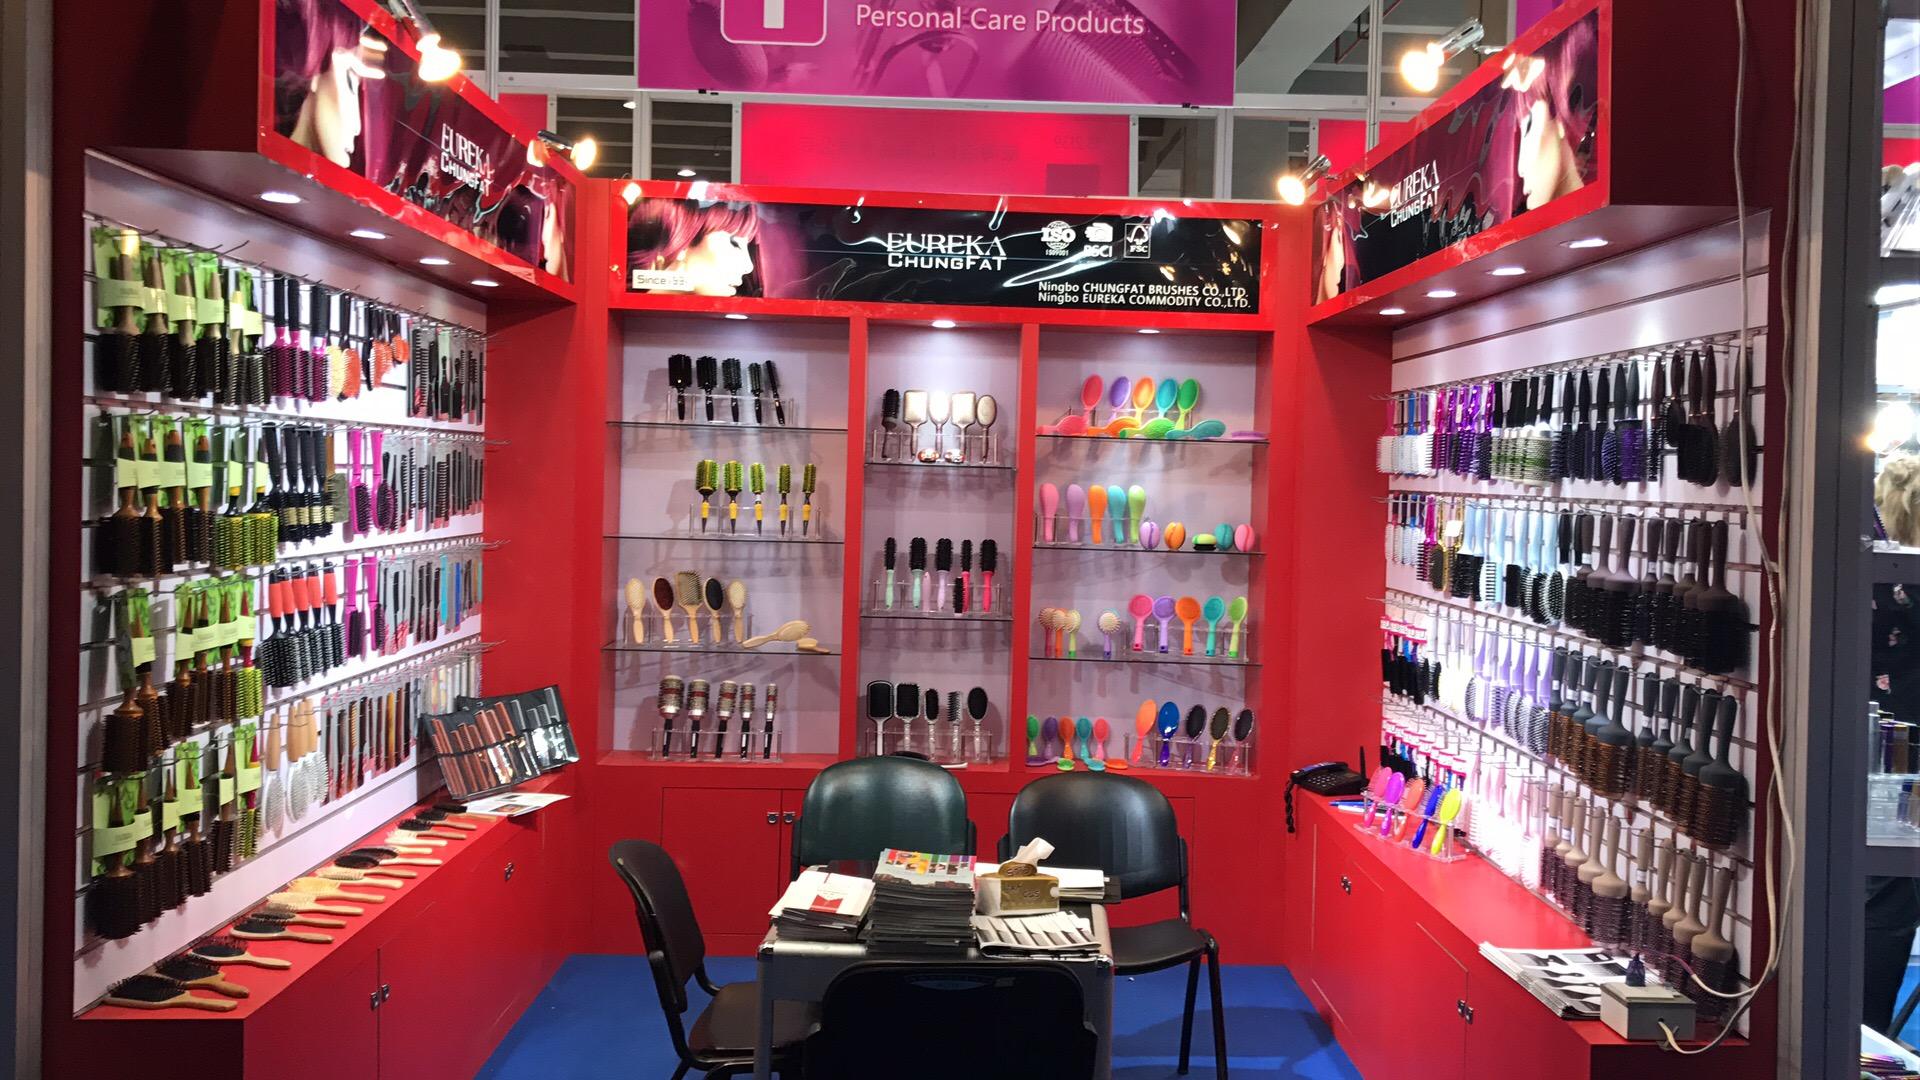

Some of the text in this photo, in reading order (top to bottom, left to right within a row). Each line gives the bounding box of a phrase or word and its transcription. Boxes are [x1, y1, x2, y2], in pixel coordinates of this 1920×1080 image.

[856, 5, 1145, 34] Personal Care Products
[441, 123, 492, 179] EUREKA
[440, 152, 494, 197] CHUNGFAT
[1390, 185, 1440, 228] CHUNGFAT
[887, 232, 1007, 256] EUREKA
[1041, 227, 1076, 243] ISO
[888, 253, 1007, 271] CHUNGFAT
[637, 275, 667, 285] Since
[1038, 281, 1080, 294] Ningbo
[1082, 283, 1145, 294] CHUNGFAT
[1148, 284, 1200, 296] BRUSHES
[1038, 292, 1080, 305] Ningbo
[1082, 294, 1126, 304] EUREKA
[1128, 295, 1202, 307] COMMODITY
